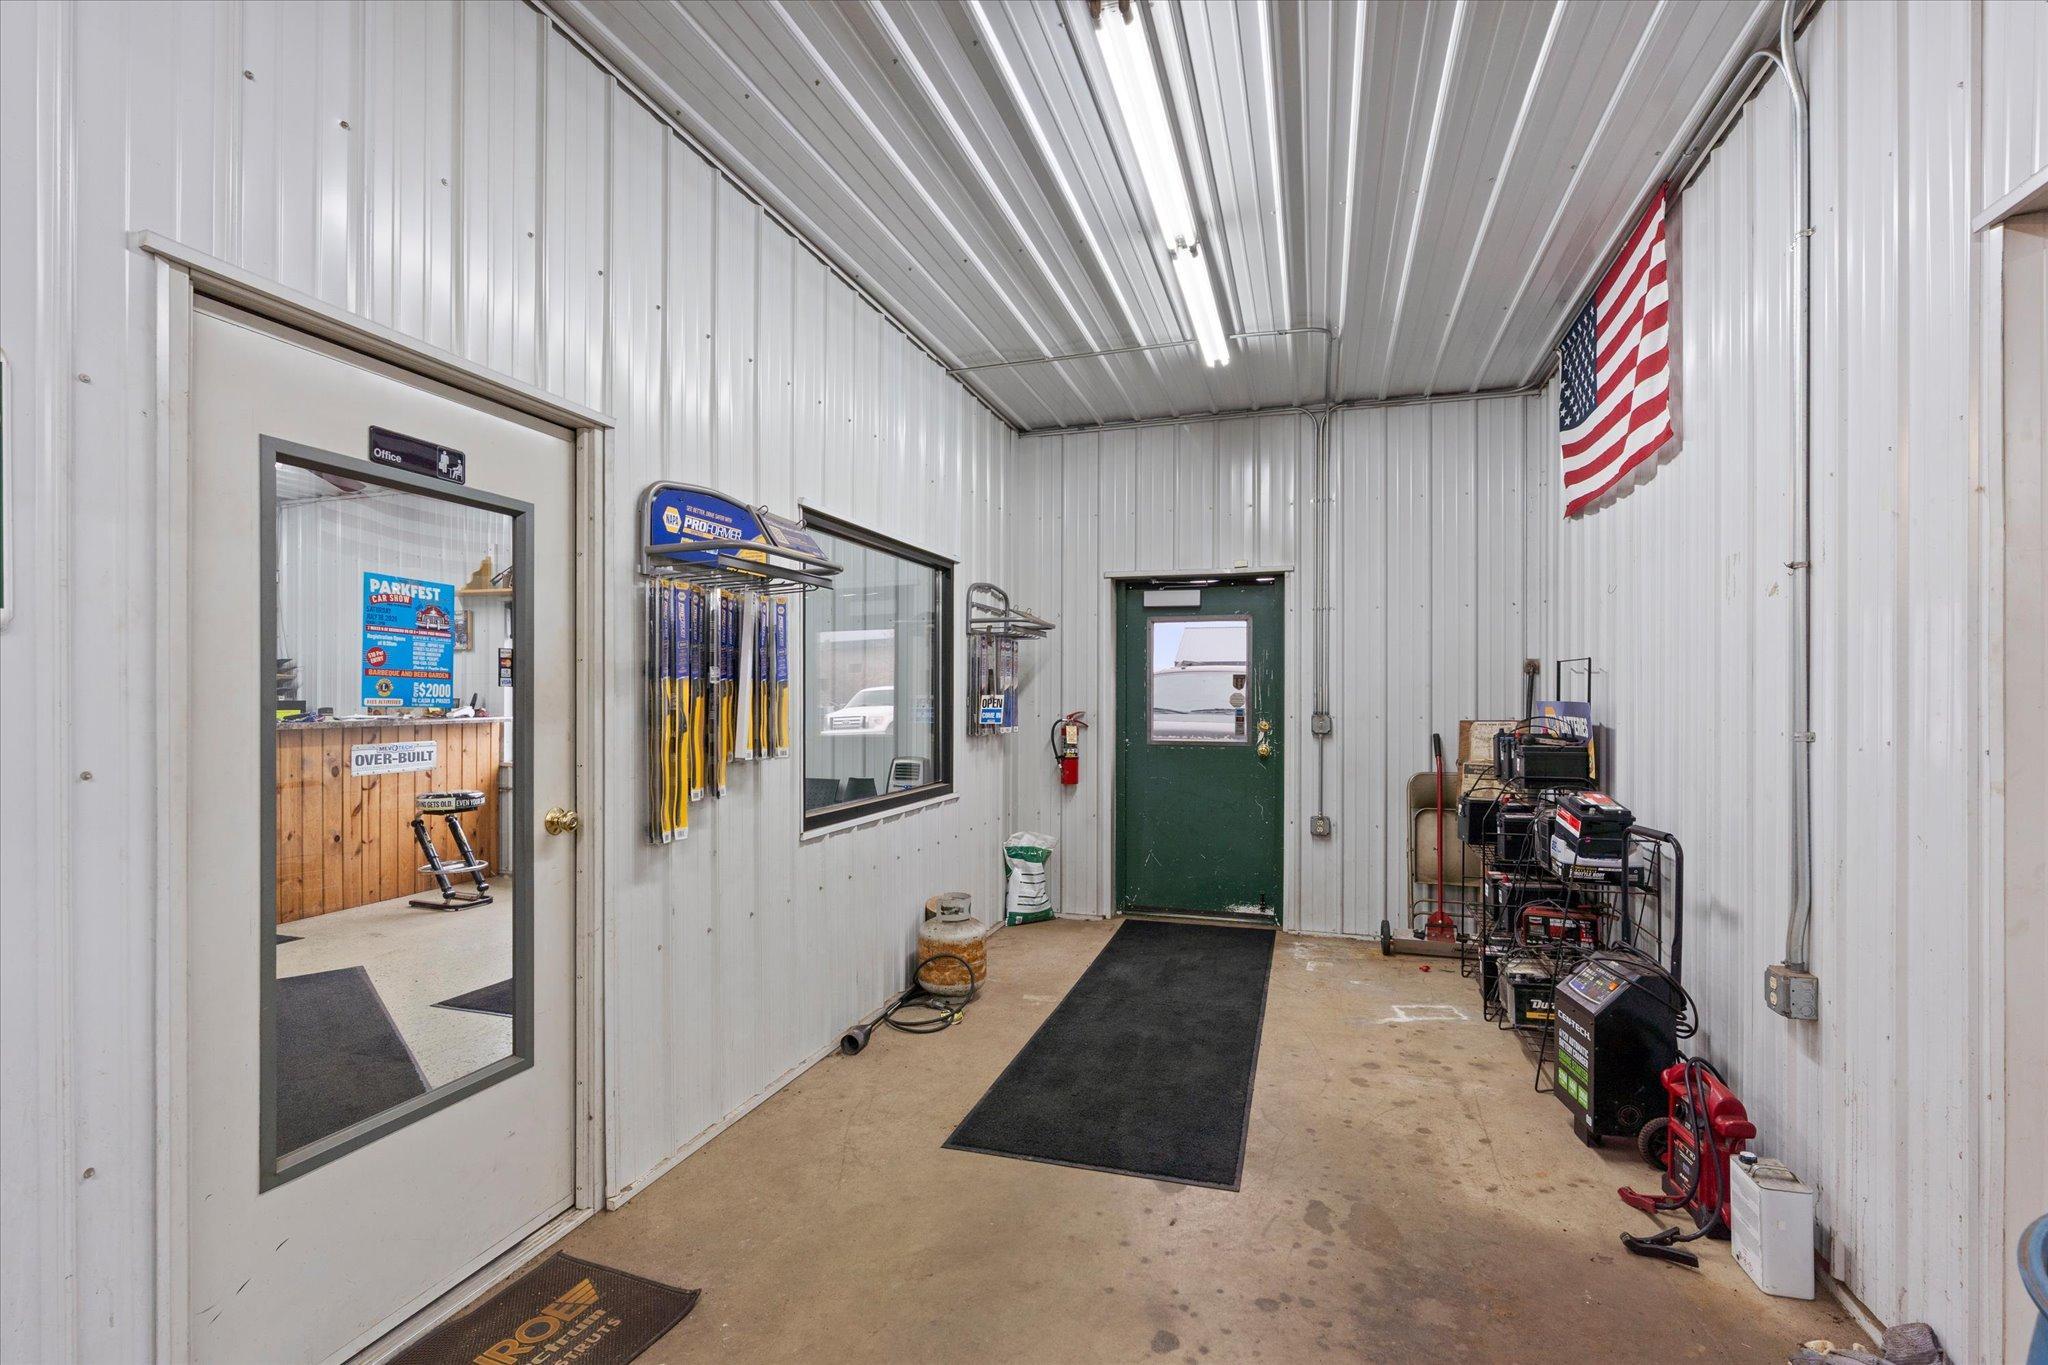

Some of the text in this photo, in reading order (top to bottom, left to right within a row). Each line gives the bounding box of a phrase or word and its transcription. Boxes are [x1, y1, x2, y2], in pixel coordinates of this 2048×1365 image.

[374, 448, 402, 463] Office
[684, 516, 743, 541] PROFORMER
[369, 578, 441, 601] PARKFEST
[371, 594, 411, 604] CAR SHOW
[368, 669, 400, 677] BARBEQUE
[418, 682, 451, 698] $2000
[982, 698, 1003, 708] OPEN
[355, 750, 434, 766] OVER-BUILT
